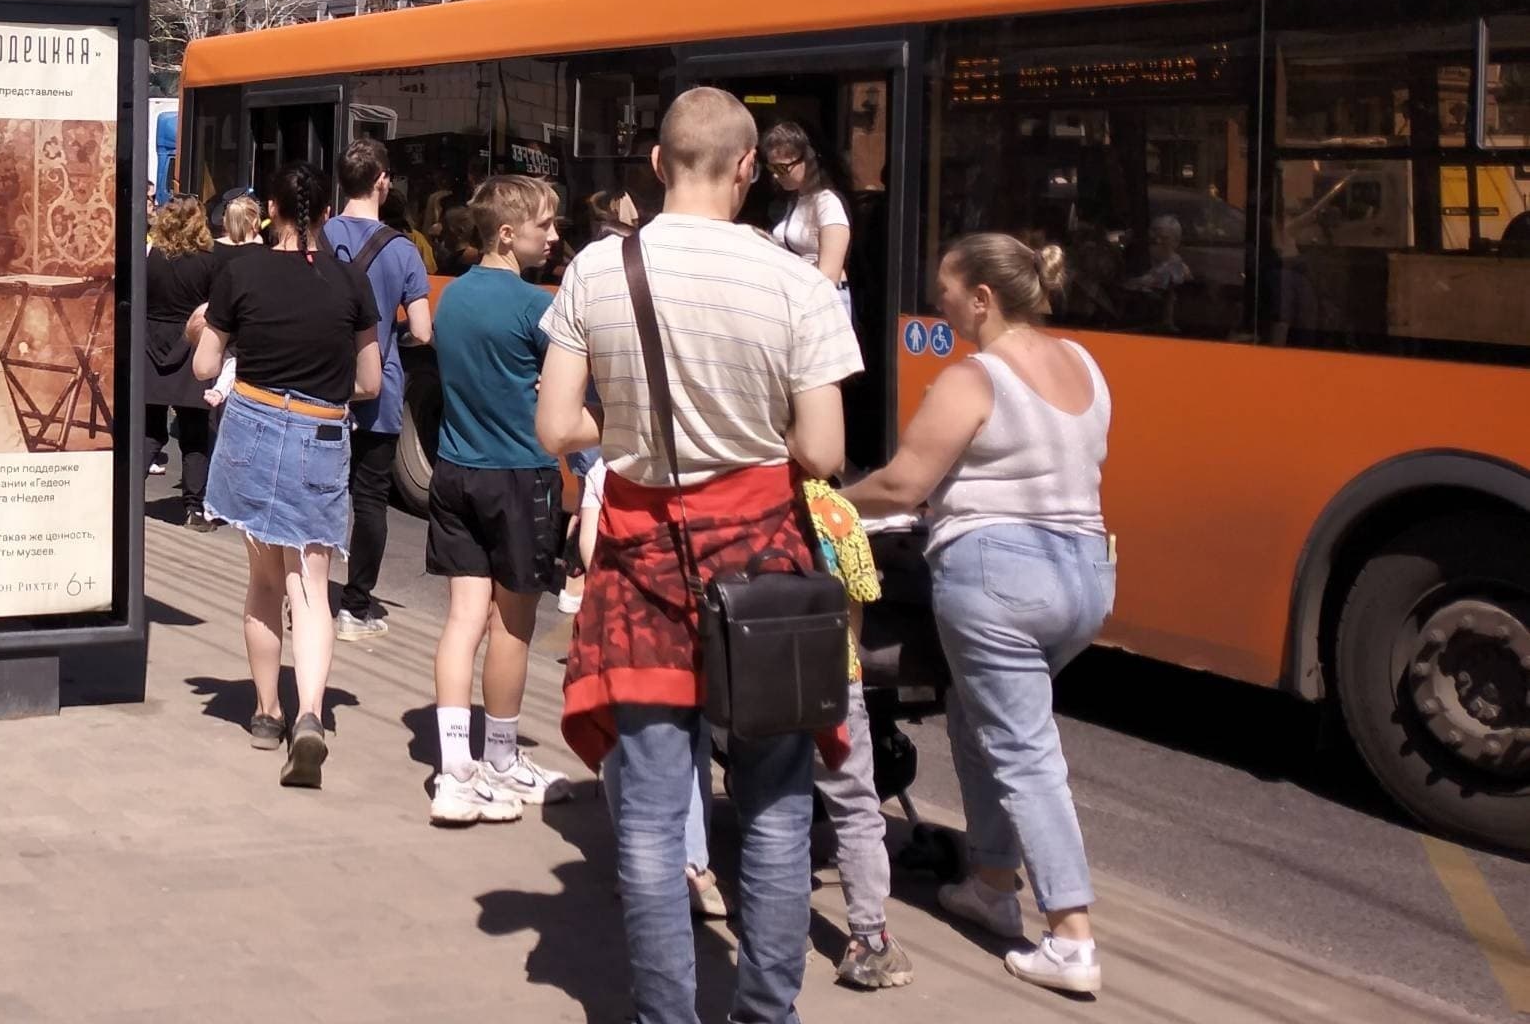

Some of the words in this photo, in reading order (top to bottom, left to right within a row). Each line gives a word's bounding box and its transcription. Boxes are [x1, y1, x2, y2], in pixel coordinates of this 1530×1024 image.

[0, 465, 20, 475] при
[22, 463, 79, 474] поддержке
[29, 478, 70, 489] «Гедеон
[10, 493, 55, 504] «Неделя
[29, 533, 43, 541] же
[45, 531, 95, 543] ценность,
[66, 572, 96, 597] 6+
